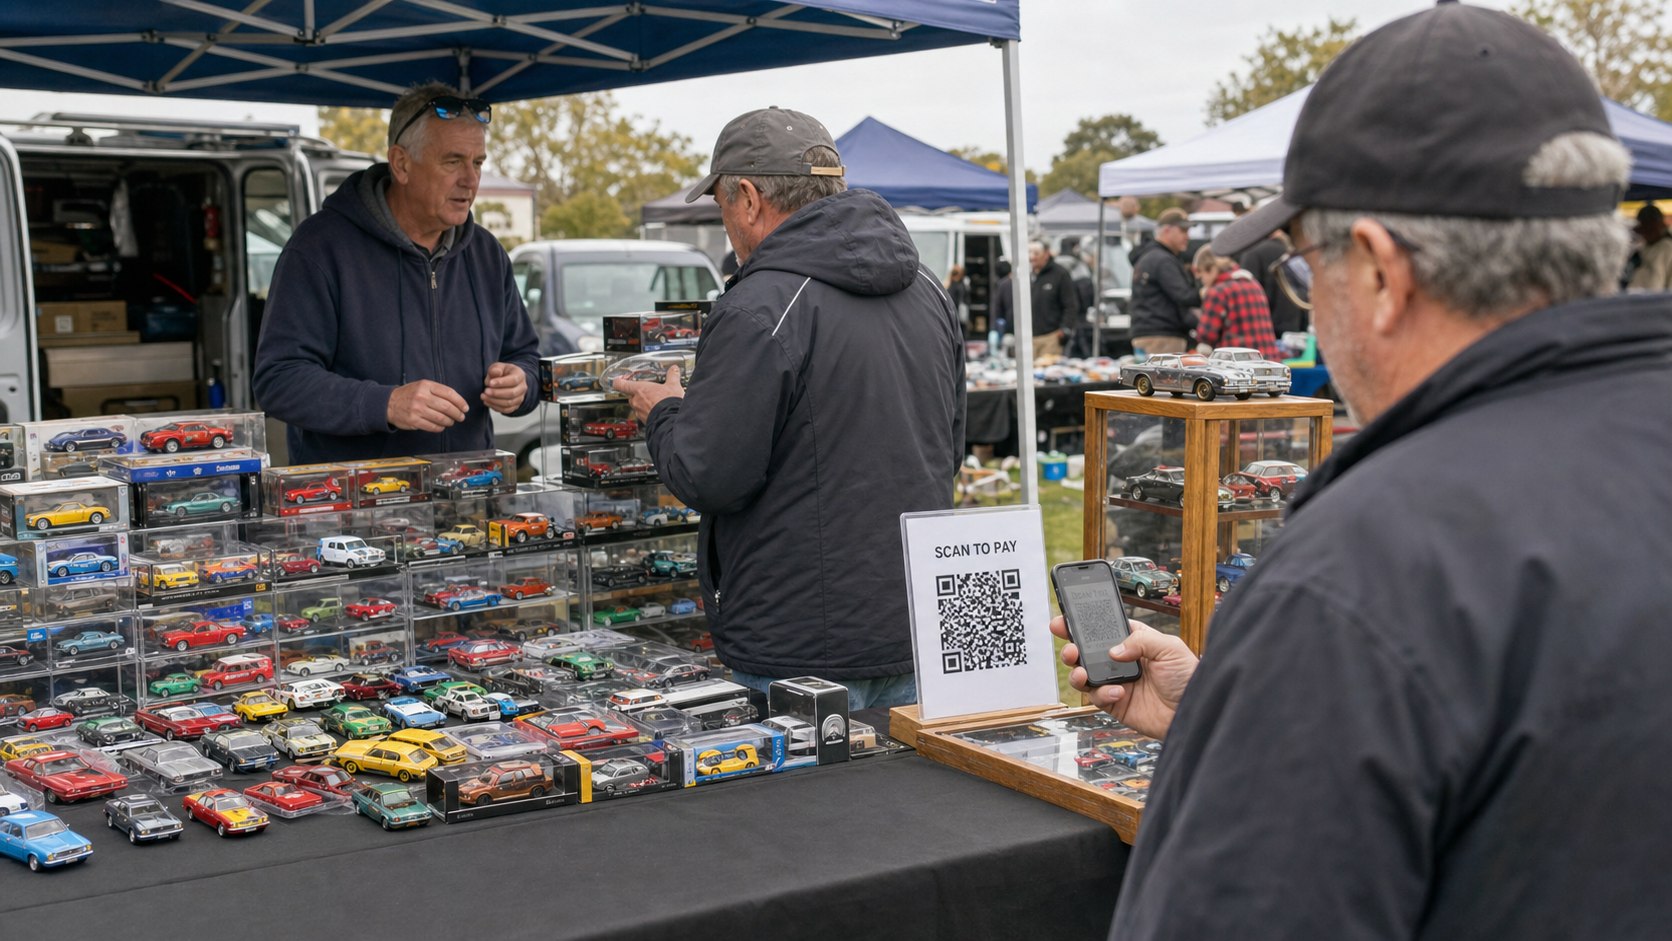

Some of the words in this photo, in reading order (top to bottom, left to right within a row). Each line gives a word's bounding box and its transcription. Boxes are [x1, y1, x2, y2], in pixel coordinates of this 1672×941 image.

[934, 544, 970, 559] SCAN
[973, 542, 991, 555] TO
[993, 540, 1017, 554] PAY
